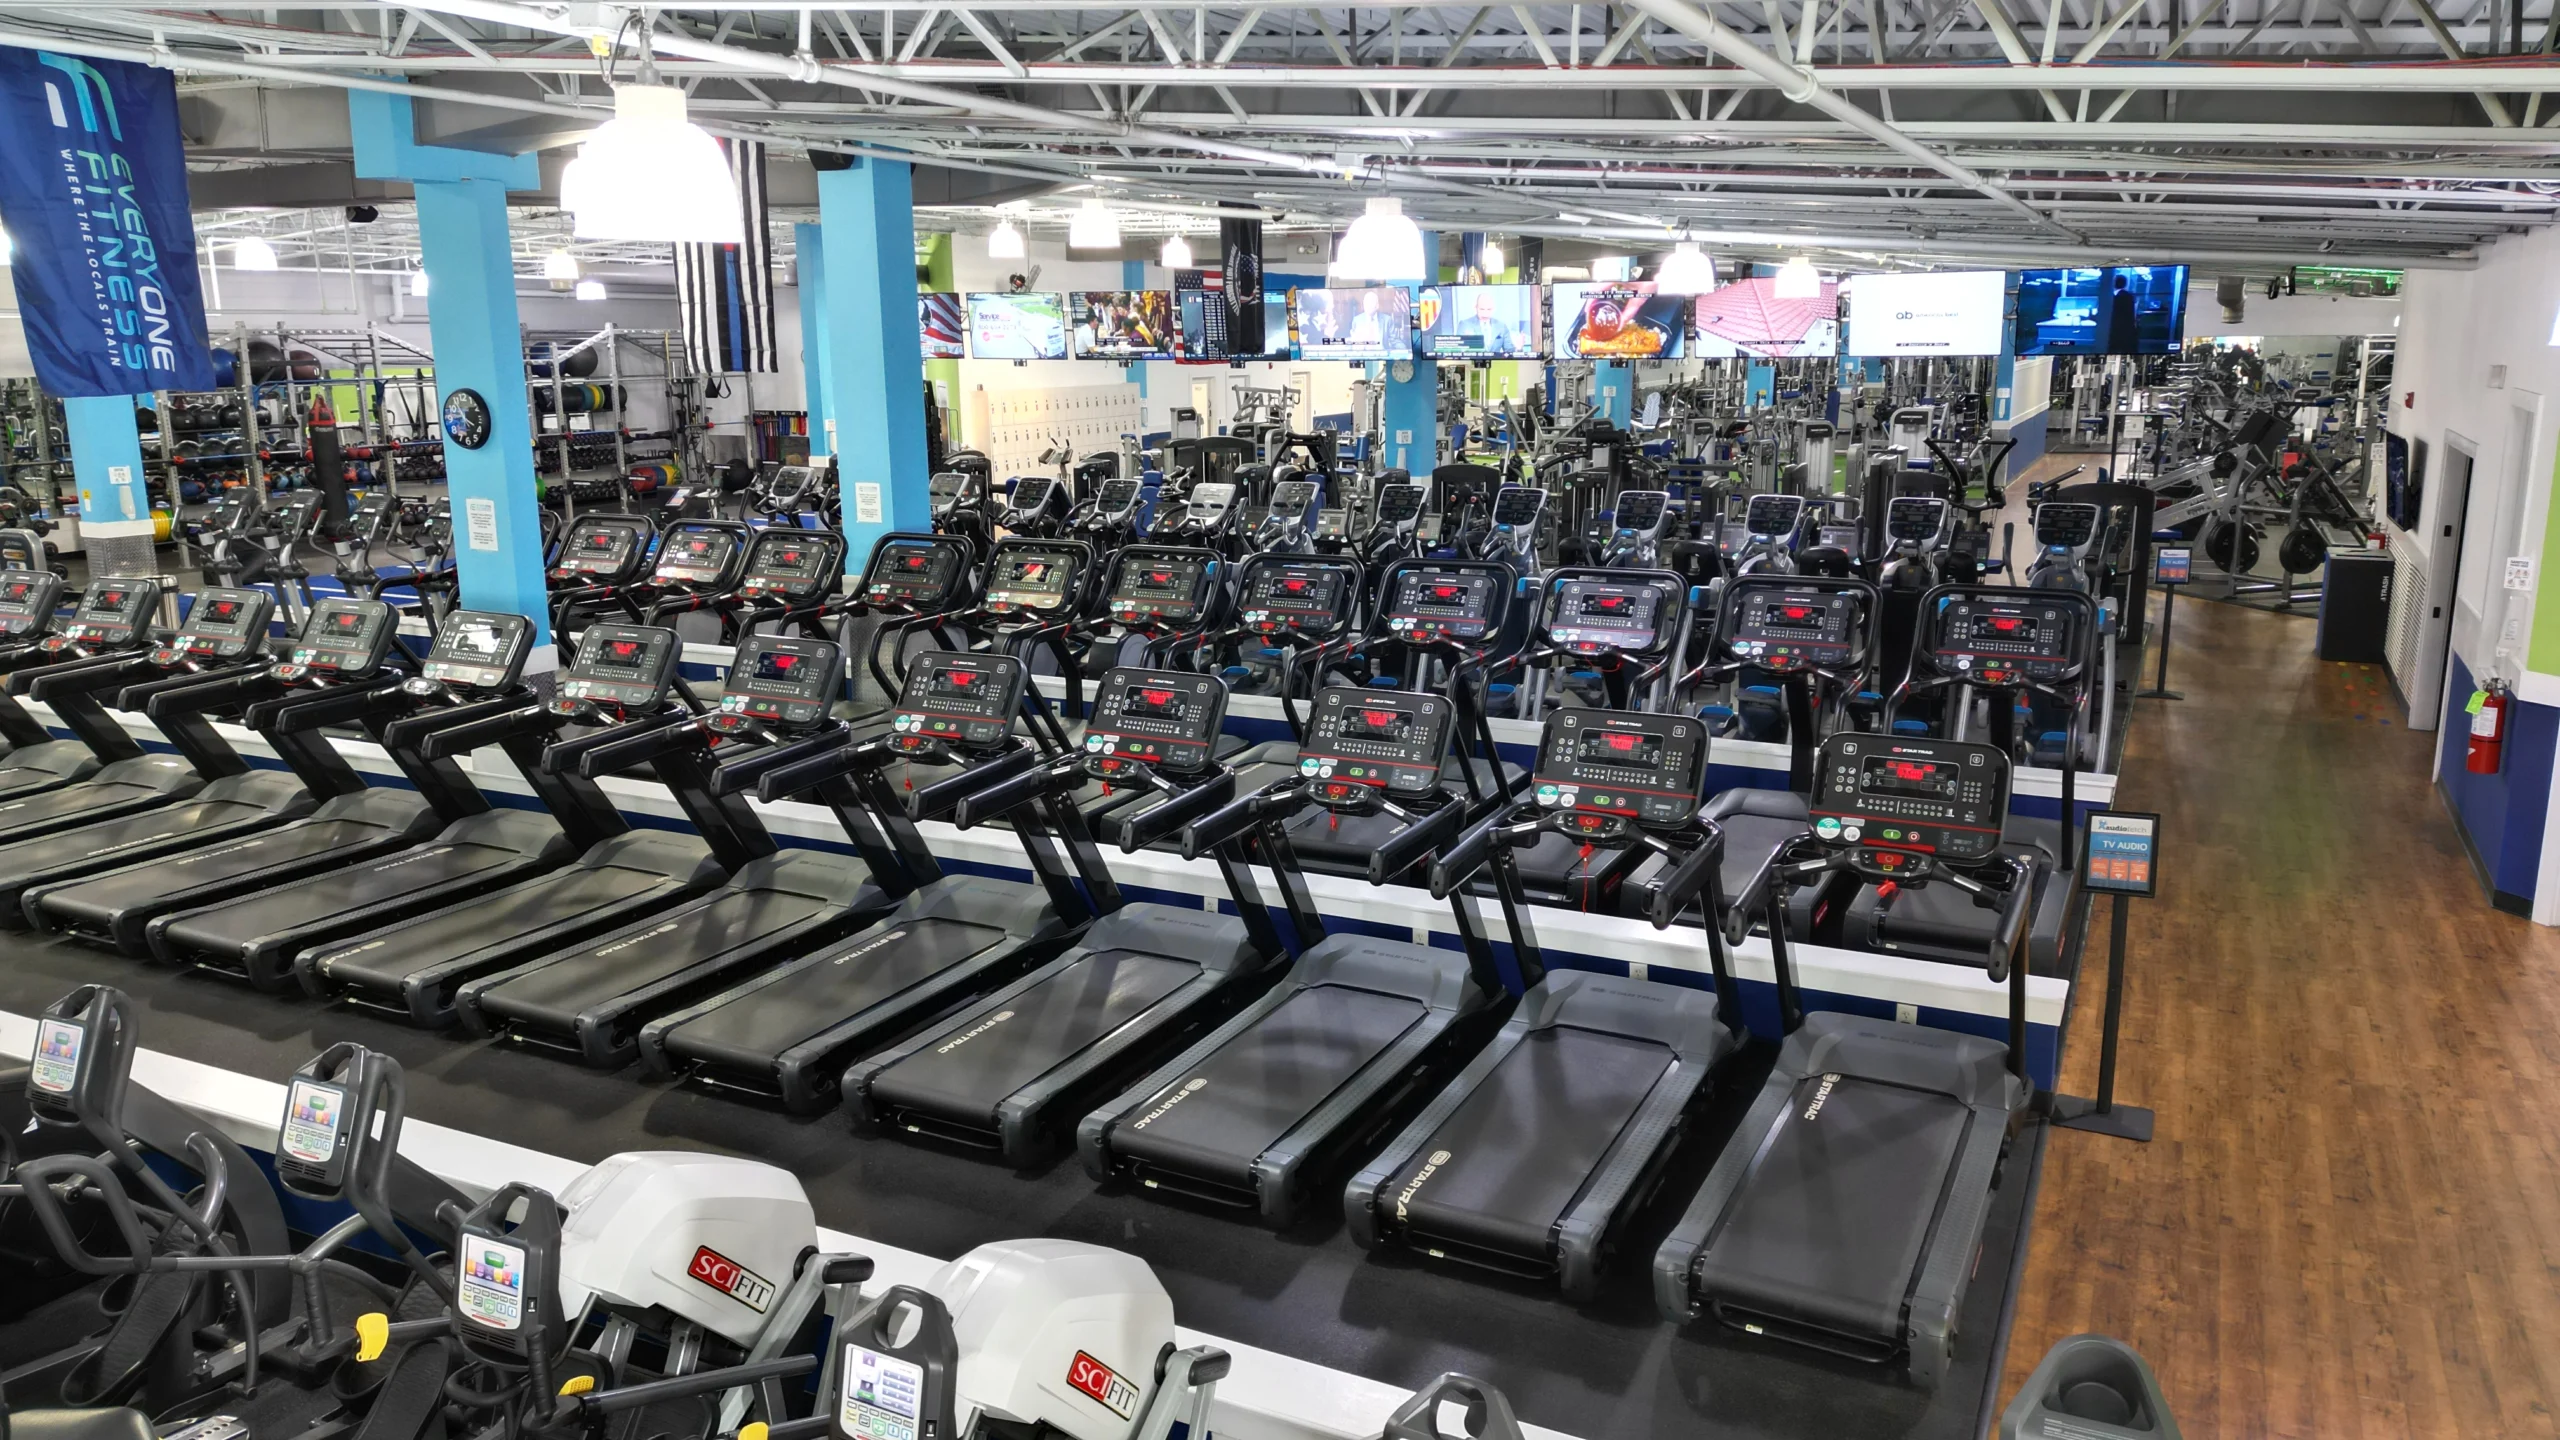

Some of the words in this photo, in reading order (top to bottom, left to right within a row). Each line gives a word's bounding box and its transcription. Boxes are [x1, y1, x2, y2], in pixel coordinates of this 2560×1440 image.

[61, 148, 85, 206] WHERE
[77, 211, 94, 243] THE
[86, 248, 109, 311] LOCALS
[100, 317, 122, 367] TRAIN
[77, 149, 149, 371] FITNESS
[111, 152, 176, 373] EVERYONE
[1225, 266, 1234, 280] NOT
[1225, 280, 1240, 317] FORGOTTEN
[458, 393, 467, 402] 12
[469, 396, 473, 404] 1
[449, 405, 457, 413] 10
[474, 403, 480, 411] 2
[447, 414, 453, 423] 9
[451, 425, 457, 434] 8
[458, 434, 463, 442] 7
[465, 436, 471, 445] 6
[473, 434, 479, 442] 5
[2103, 840, 2116, 848] TV
[2117, 841, 2148, 851] AUDIO
[1161, 1089, 1190, 1110] STAR
[1133, 1108, 1166, 1130] TRAC
[1409, 1164, 1436, 1188] STAR
[695, 1255, 770, 1304] SCIFIT
[1073, 1361, 1135, 1411] SCIFIT
